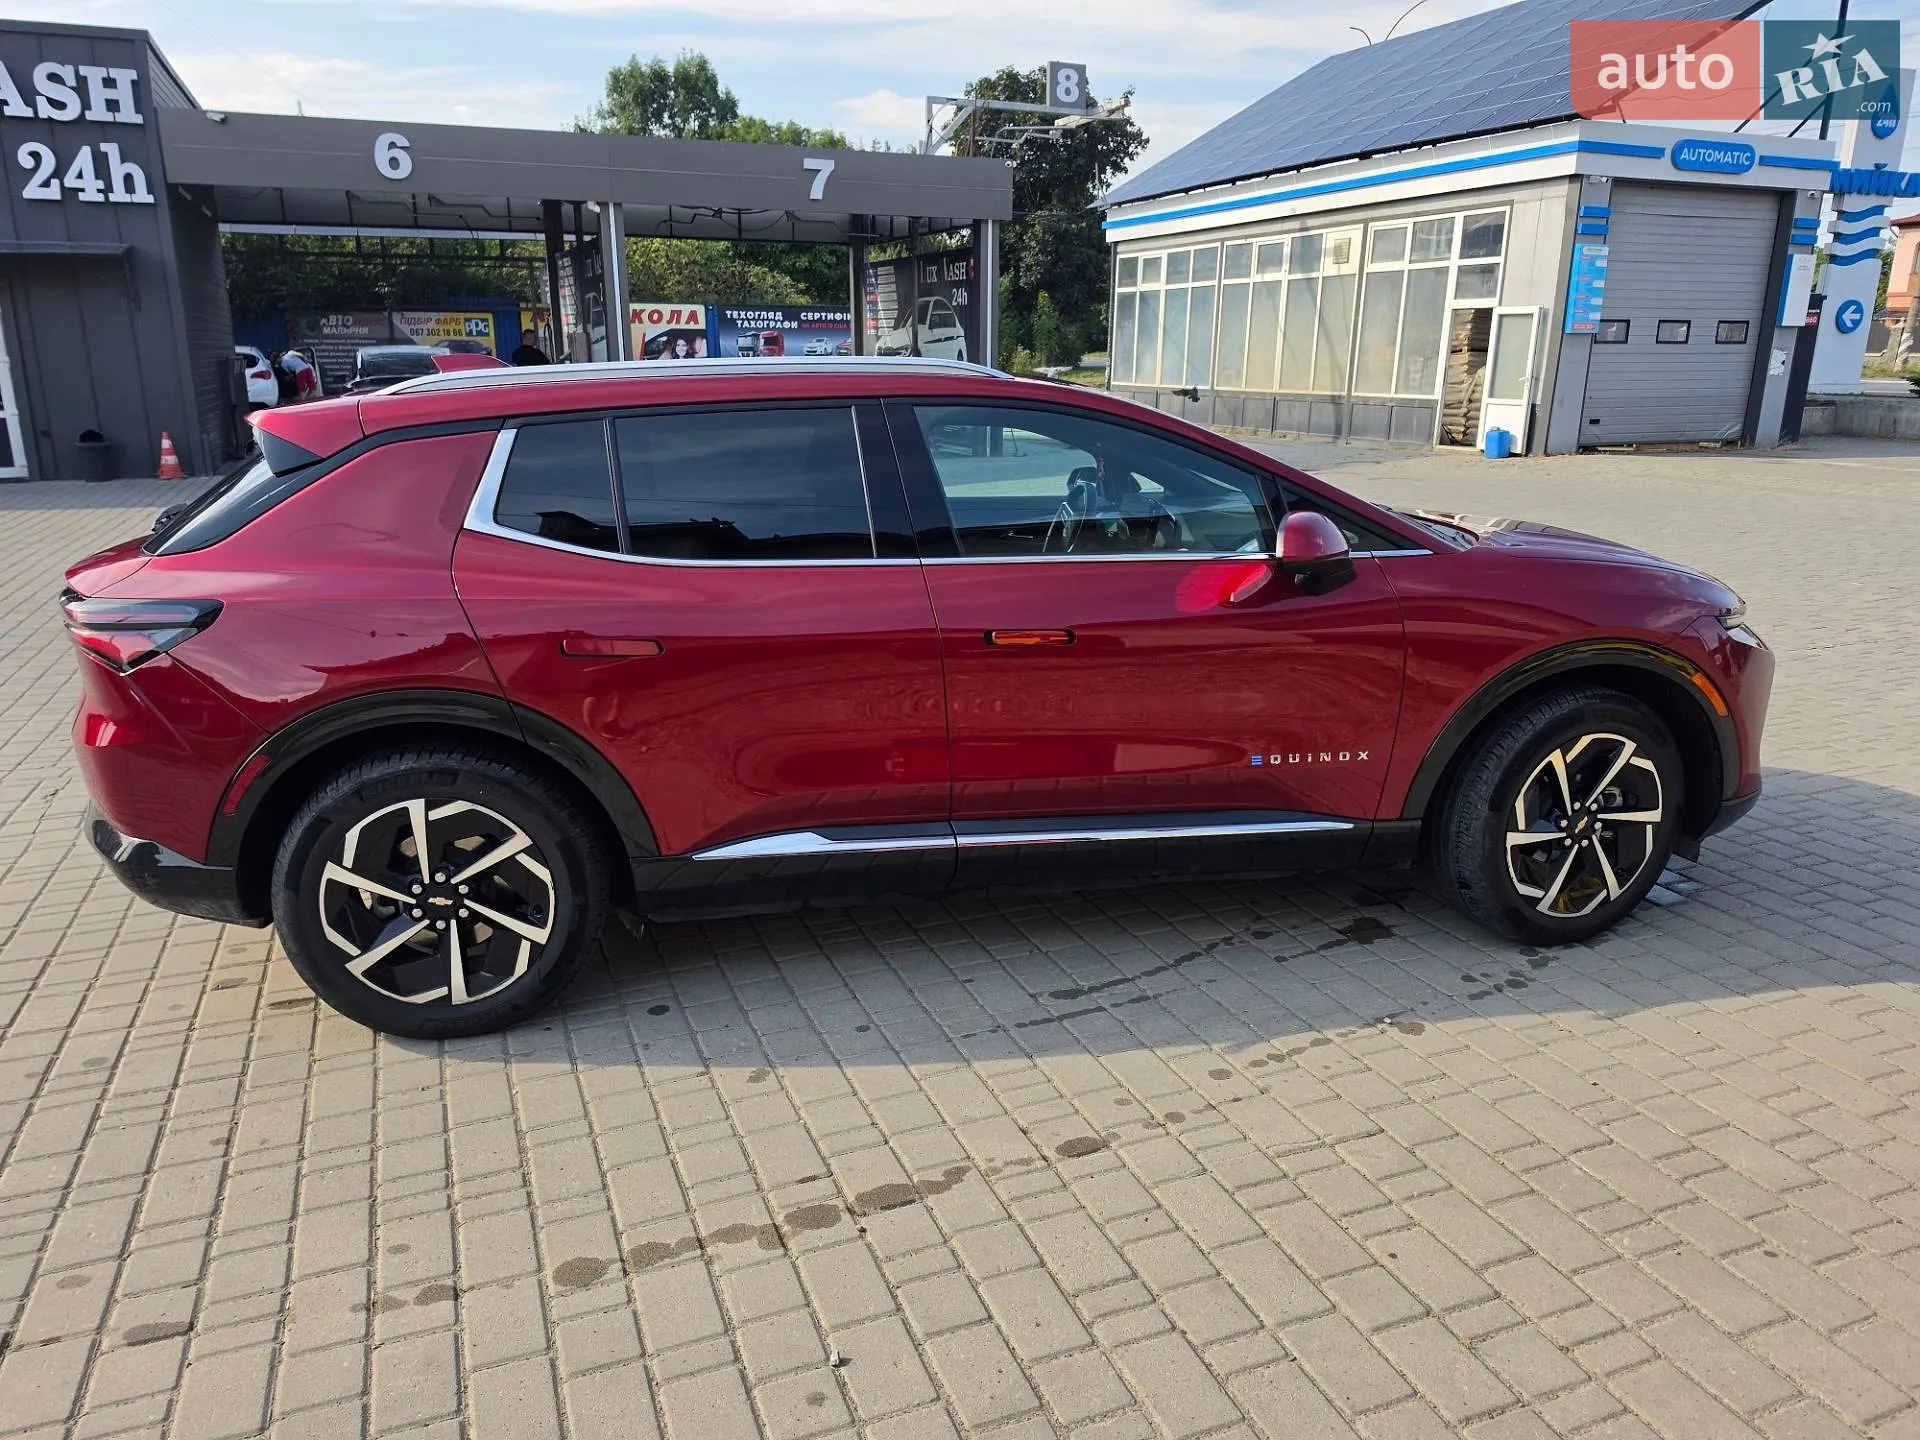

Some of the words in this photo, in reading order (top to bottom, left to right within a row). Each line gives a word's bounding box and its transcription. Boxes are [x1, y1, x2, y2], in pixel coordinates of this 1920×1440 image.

[1056, 68, 1080, 103] 8
[373, 131, 414, 180] 6
[1680, 147, 1752, 166] AUTOMATIC
[17, 141, 155, 204] 24h
[802, 158, 836, 201] 7
[952, 288, 968, 306] 24h
[725, 311, 783, 321] ТЕХОГЛЯД
[736, 320, 798, 329] ТАХОГРАФИ
[1251, 750, 1369, 766] EQUINOX
